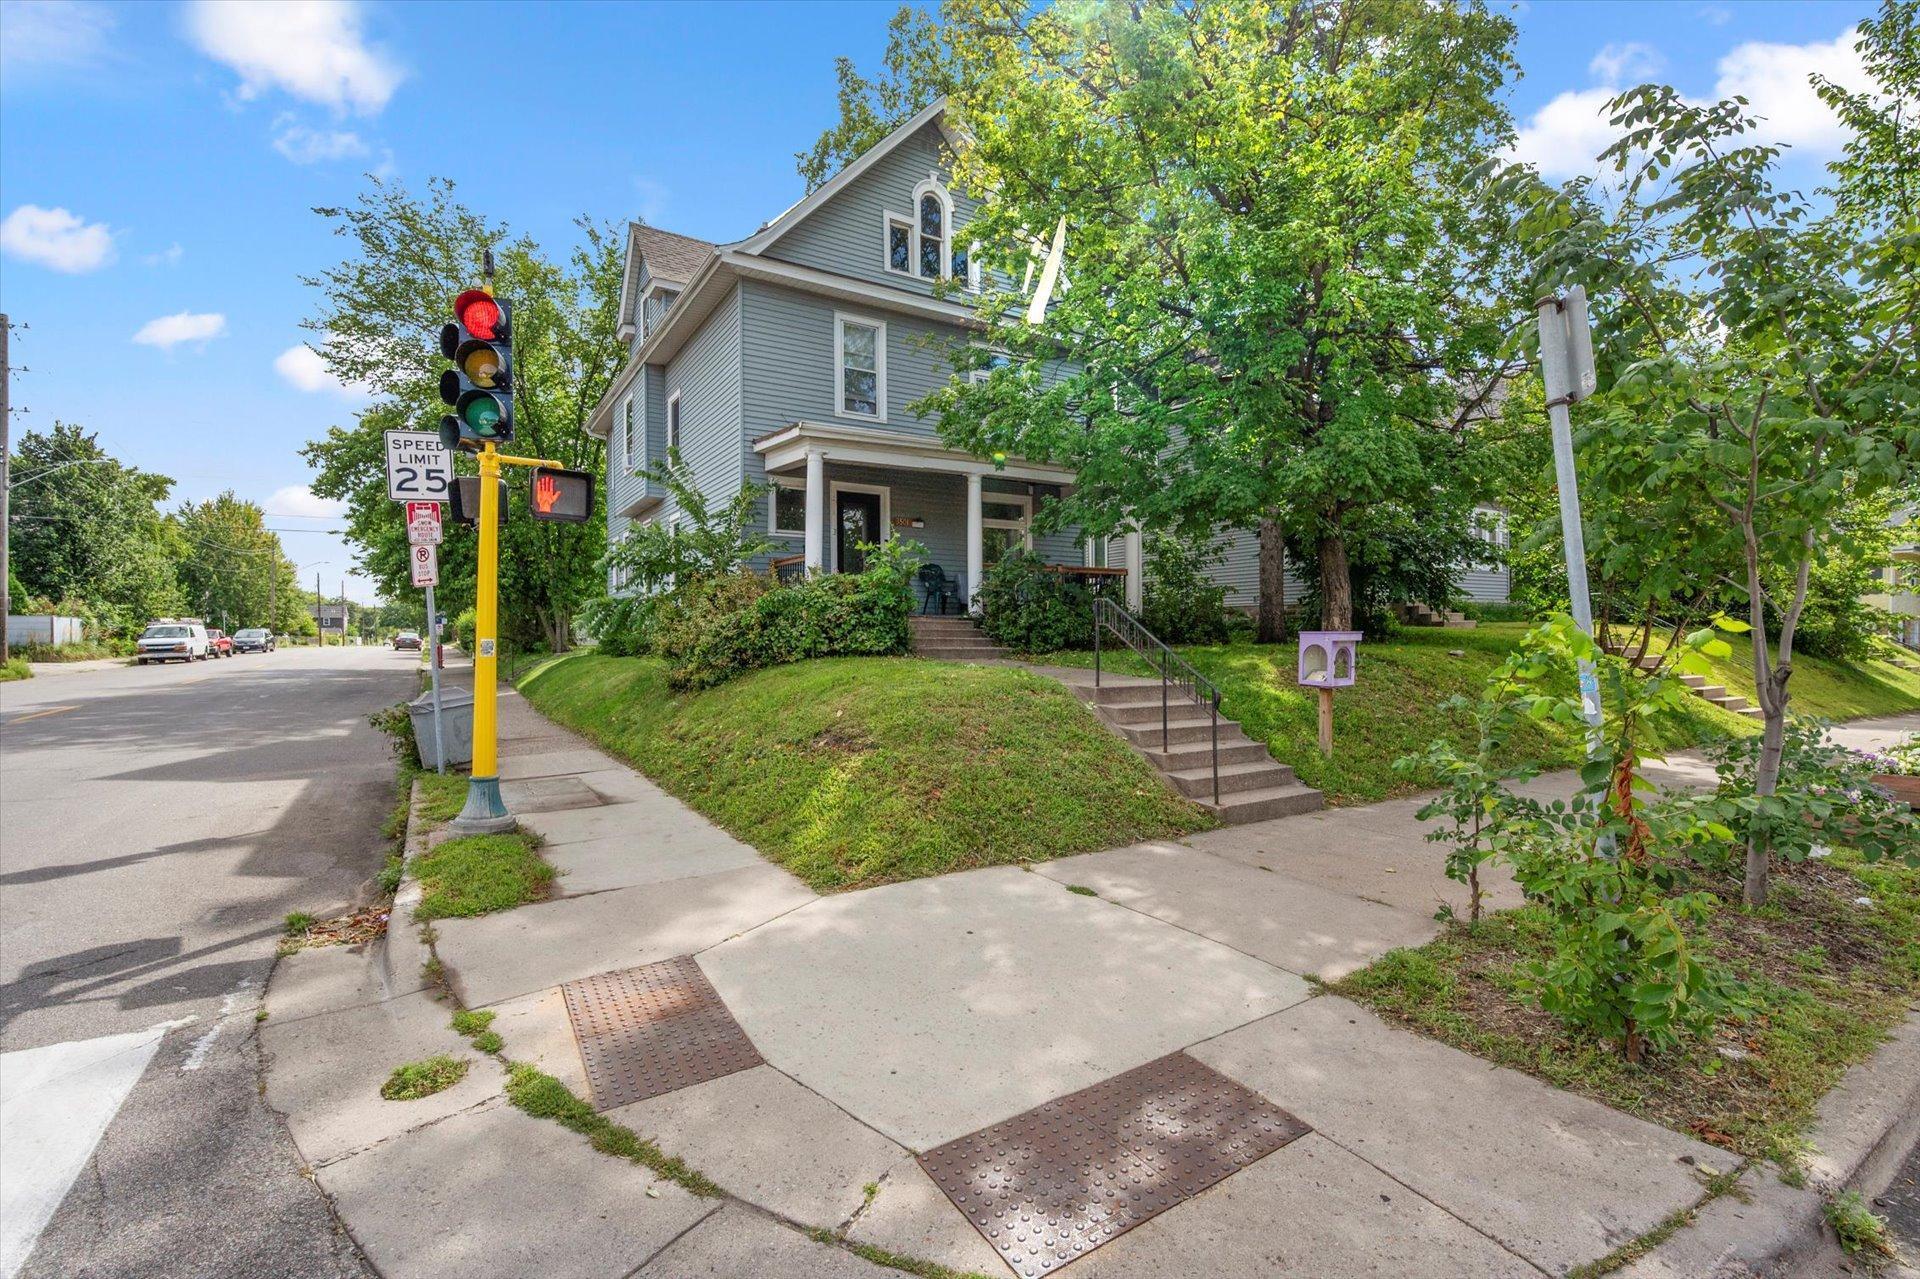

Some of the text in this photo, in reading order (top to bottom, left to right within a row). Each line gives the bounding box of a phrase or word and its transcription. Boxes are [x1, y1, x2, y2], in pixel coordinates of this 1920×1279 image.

[392, 439, 445, 452] SPEED
[399, 454, 440, 465] LIMIT
[395, 467, 447, 493] 25
